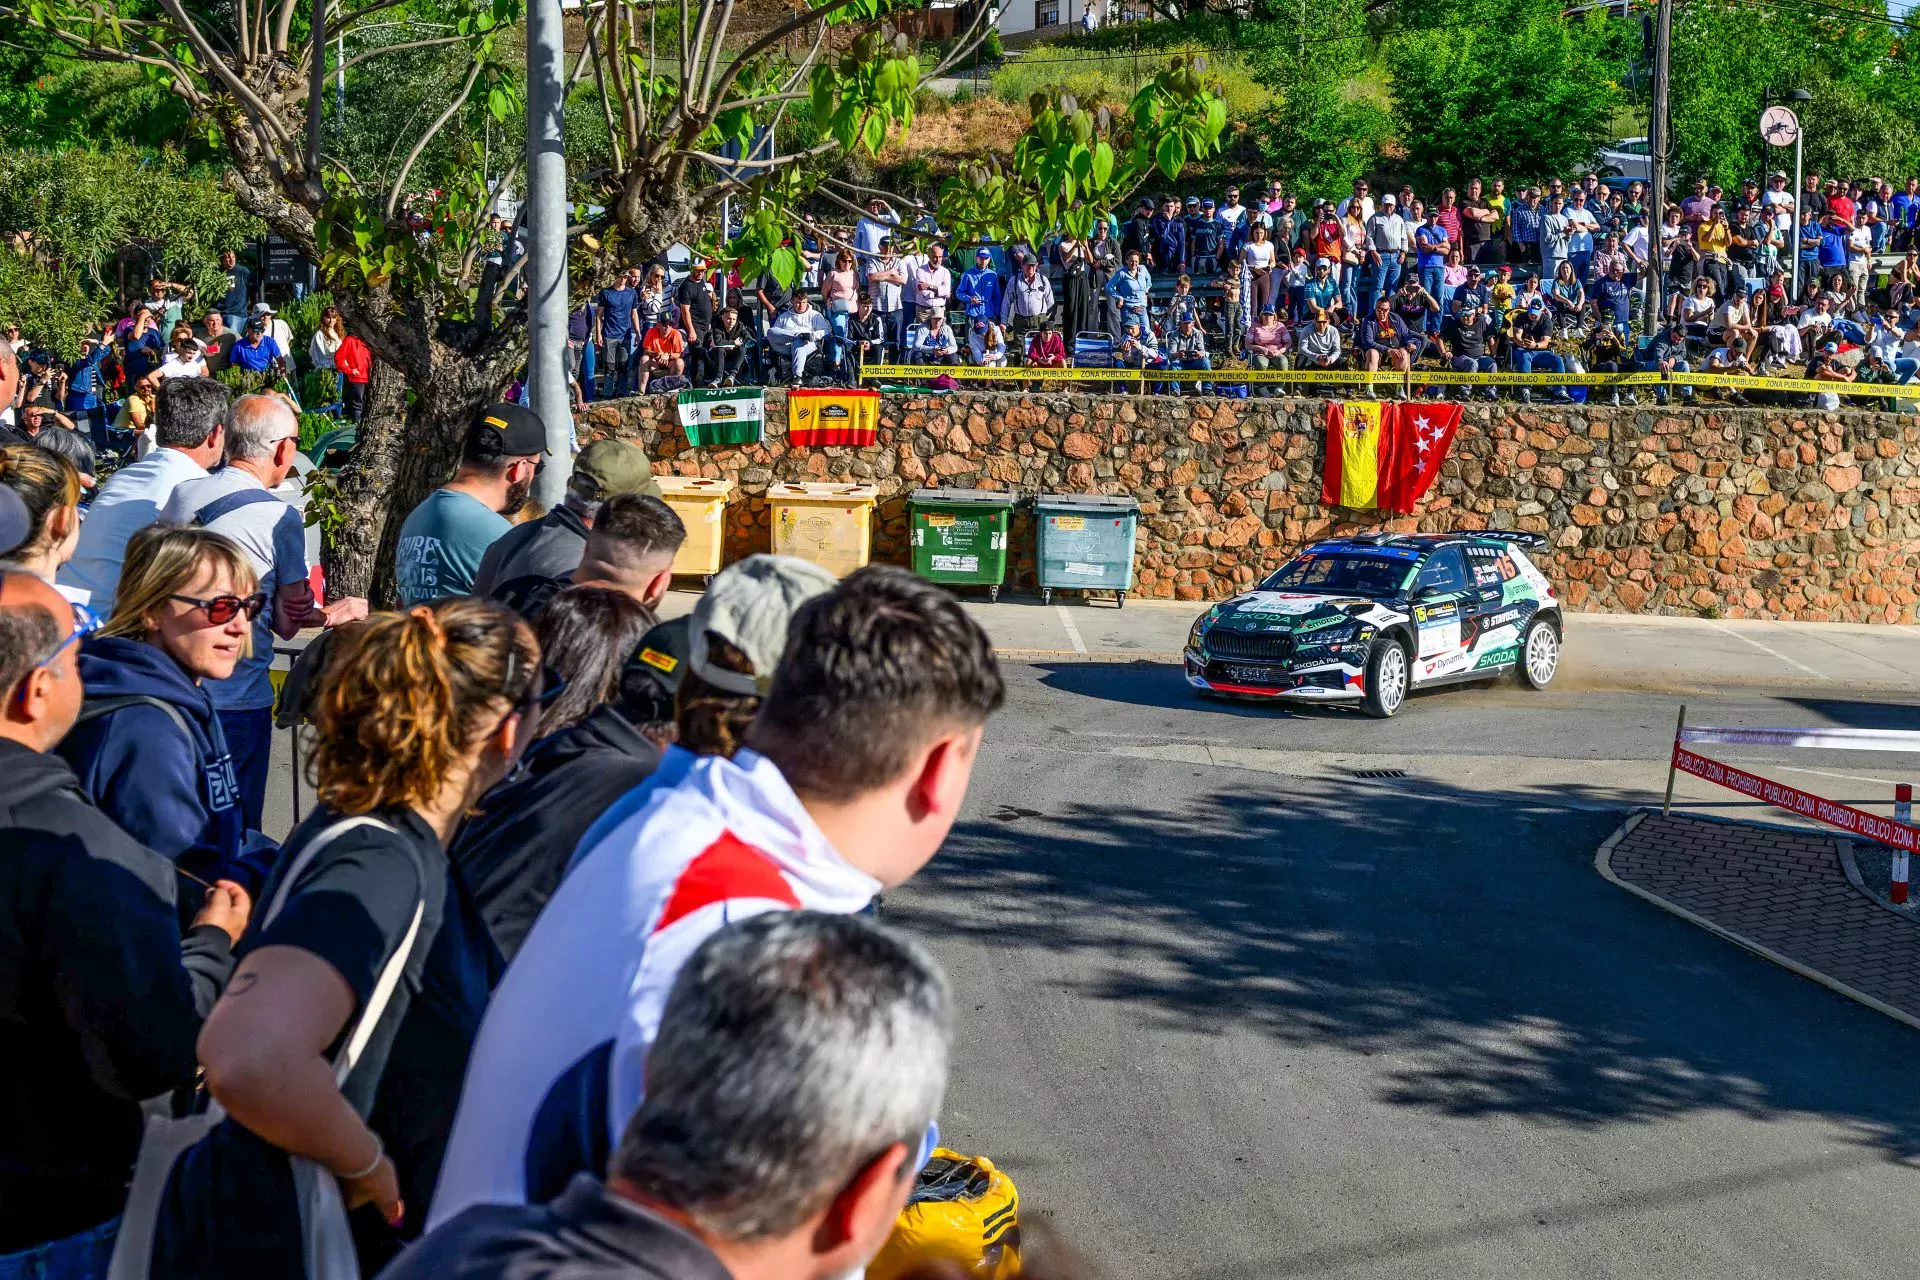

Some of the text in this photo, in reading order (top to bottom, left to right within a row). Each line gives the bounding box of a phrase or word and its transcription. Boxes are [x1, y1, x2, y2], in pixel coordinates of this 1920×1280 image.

[925, 368, 956, 376] PUBLICO
[984, 369, 1014, 377] PUBLICO
[1042, 370, 1073, 378] PUBLICO
[1198, 372, 1217, 380] ZONA
[1218, 372, 1248, 380] PUBLICO
[1429, 374, 1448, 382] ZONA
[1508, 375, 1538, 383] PUBLICO
[1566, 375, 1596, 383] PUBLICO
[1679, 375, 1707, 383] PUBLICO
[1714, 376, 1731, 384] ZONA
[1732, 378, 1760, 387] PUBLICO
[1766, 379, 1783, 388] ZONA
[1784, 380, 1811, 390] PUBLICO
[1817, 382, 1834, 391] ZONA
[1835, 383, 1862, 393] PUBLICO
[1868, 386, 1885, 394] ZONA
[1886, 386, 1912, 396] PUBLICO
[1494, 555, 1516, 581] 15
[1416, 607, 1426, 622] 15
[1490, 609, 1521, 627] STAVOSIL
[1437, 651, 1464, 669] Dynamic
[1676, 753, 1705, 775] PUBLICO
[1706, 763, 1724, 783] ZONA
[1726, 771, 1762, 796] PROHIBIDO
[1764, 783, 1794, 807] PUBLICO
[1796, 793, 1815, 815] ZONA
[1818, 802, 1856, 829] PROHIBIDO
[1859, 815, 1890, 840] PUBLICO
[1893, 826, 1914, 849] ZONA
